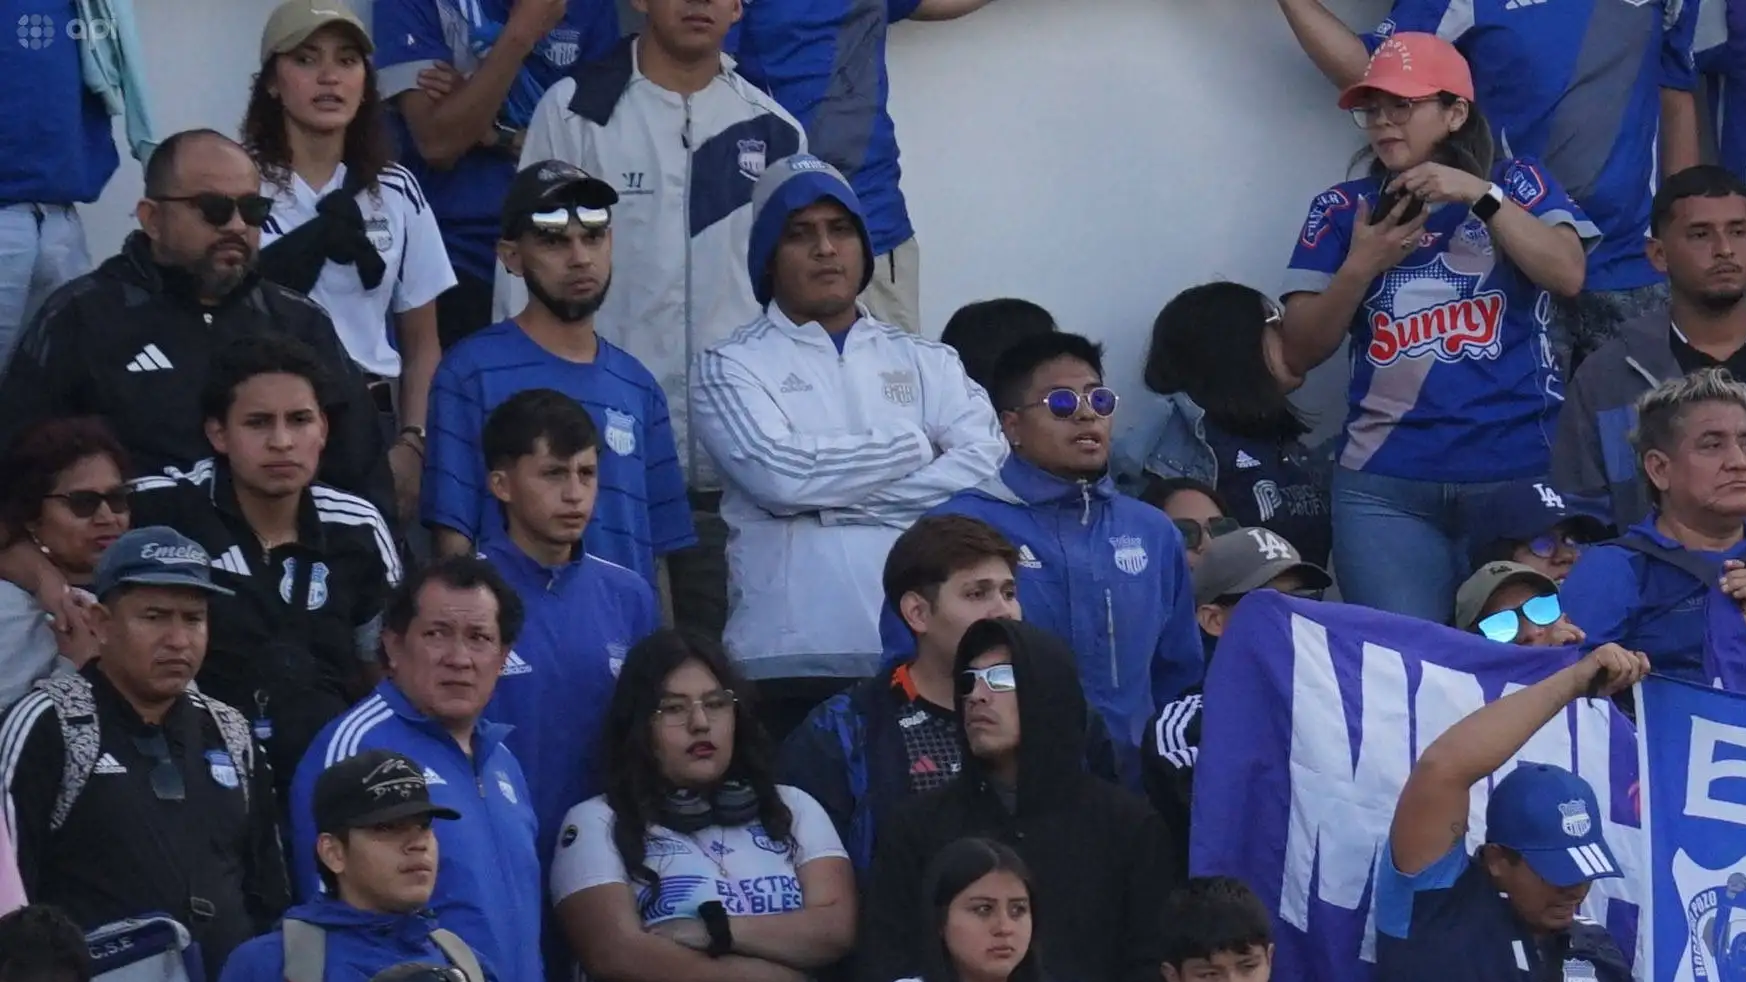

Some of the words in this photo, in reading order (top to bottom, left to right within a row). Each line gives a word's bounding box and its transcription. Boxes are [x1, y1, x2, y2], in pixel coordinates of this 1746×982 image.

[1368, 293, 1502, 361] Sunny
[1532, 483, 1566, 509] LA
[1247, 528, 1292, 561] LA
